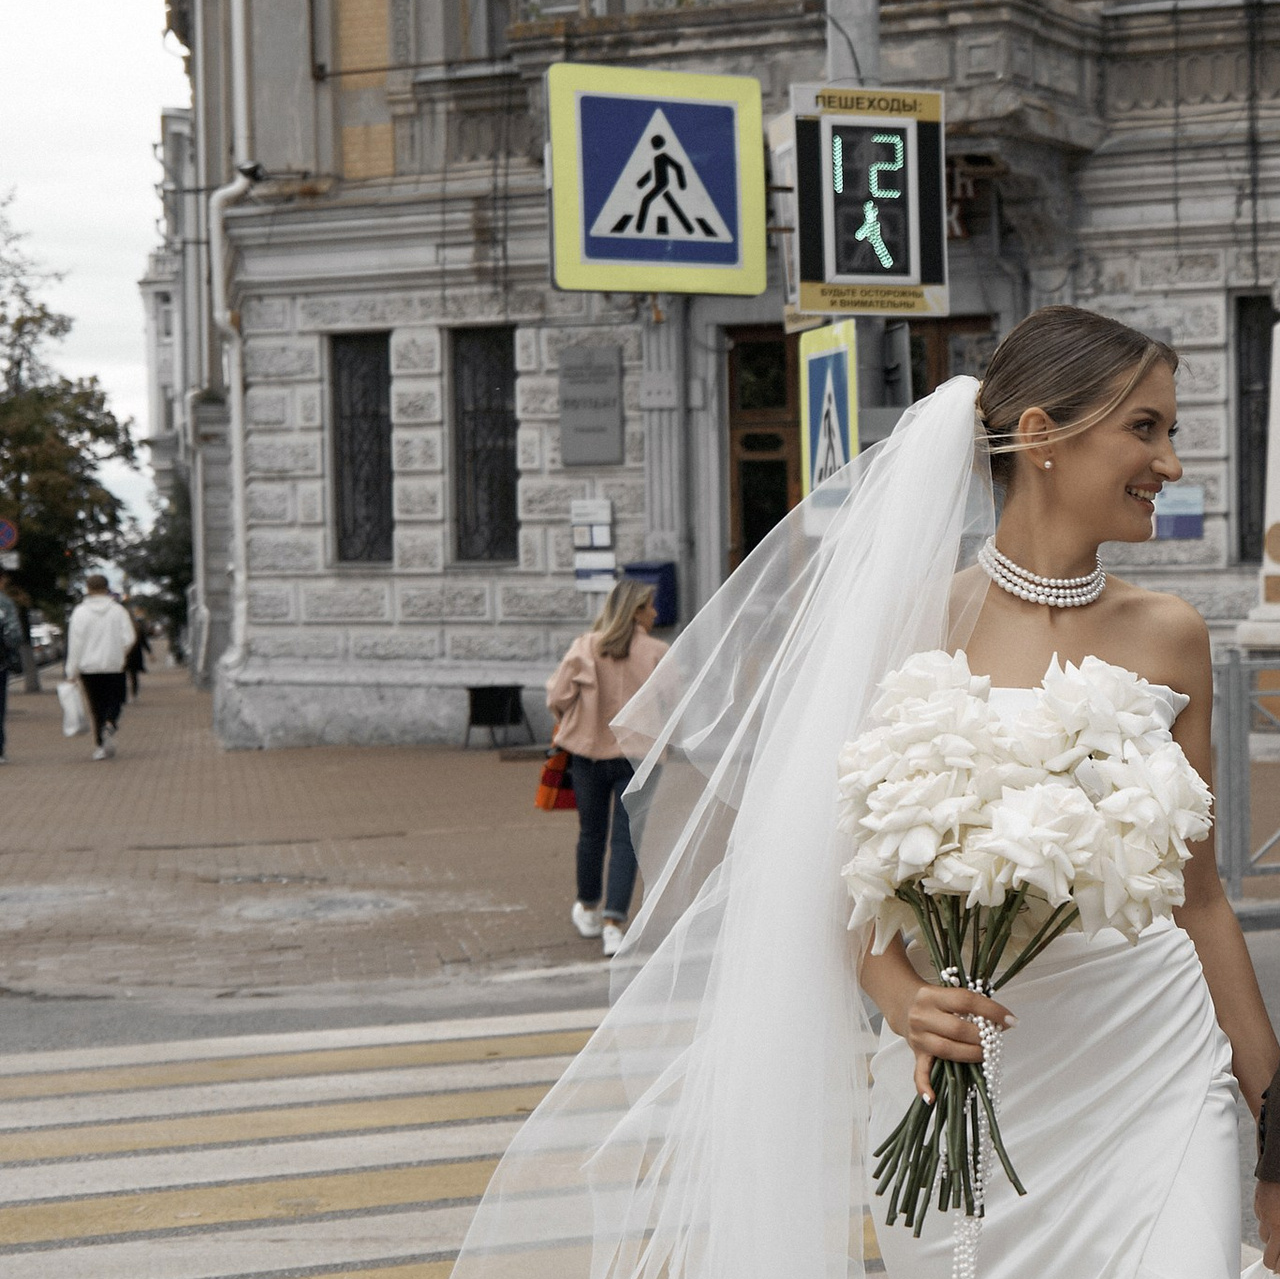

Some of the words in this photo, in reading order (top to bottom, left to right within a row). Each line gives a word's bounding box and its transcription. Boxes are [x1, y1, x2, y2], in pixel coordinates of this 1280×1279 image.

[815, 94, 922, 114] ПЕШЕХОДЫ:
[832, 133, 904, 199] 12
[820, 288, 857, 297] БУДЬТЕ
[859, 289, 924, 299] ОСТОРОЖНЫ
[830, 299, 837, 307] И
[839, 299, 916, 309] ВНИМАТЕЛЬНЫ
